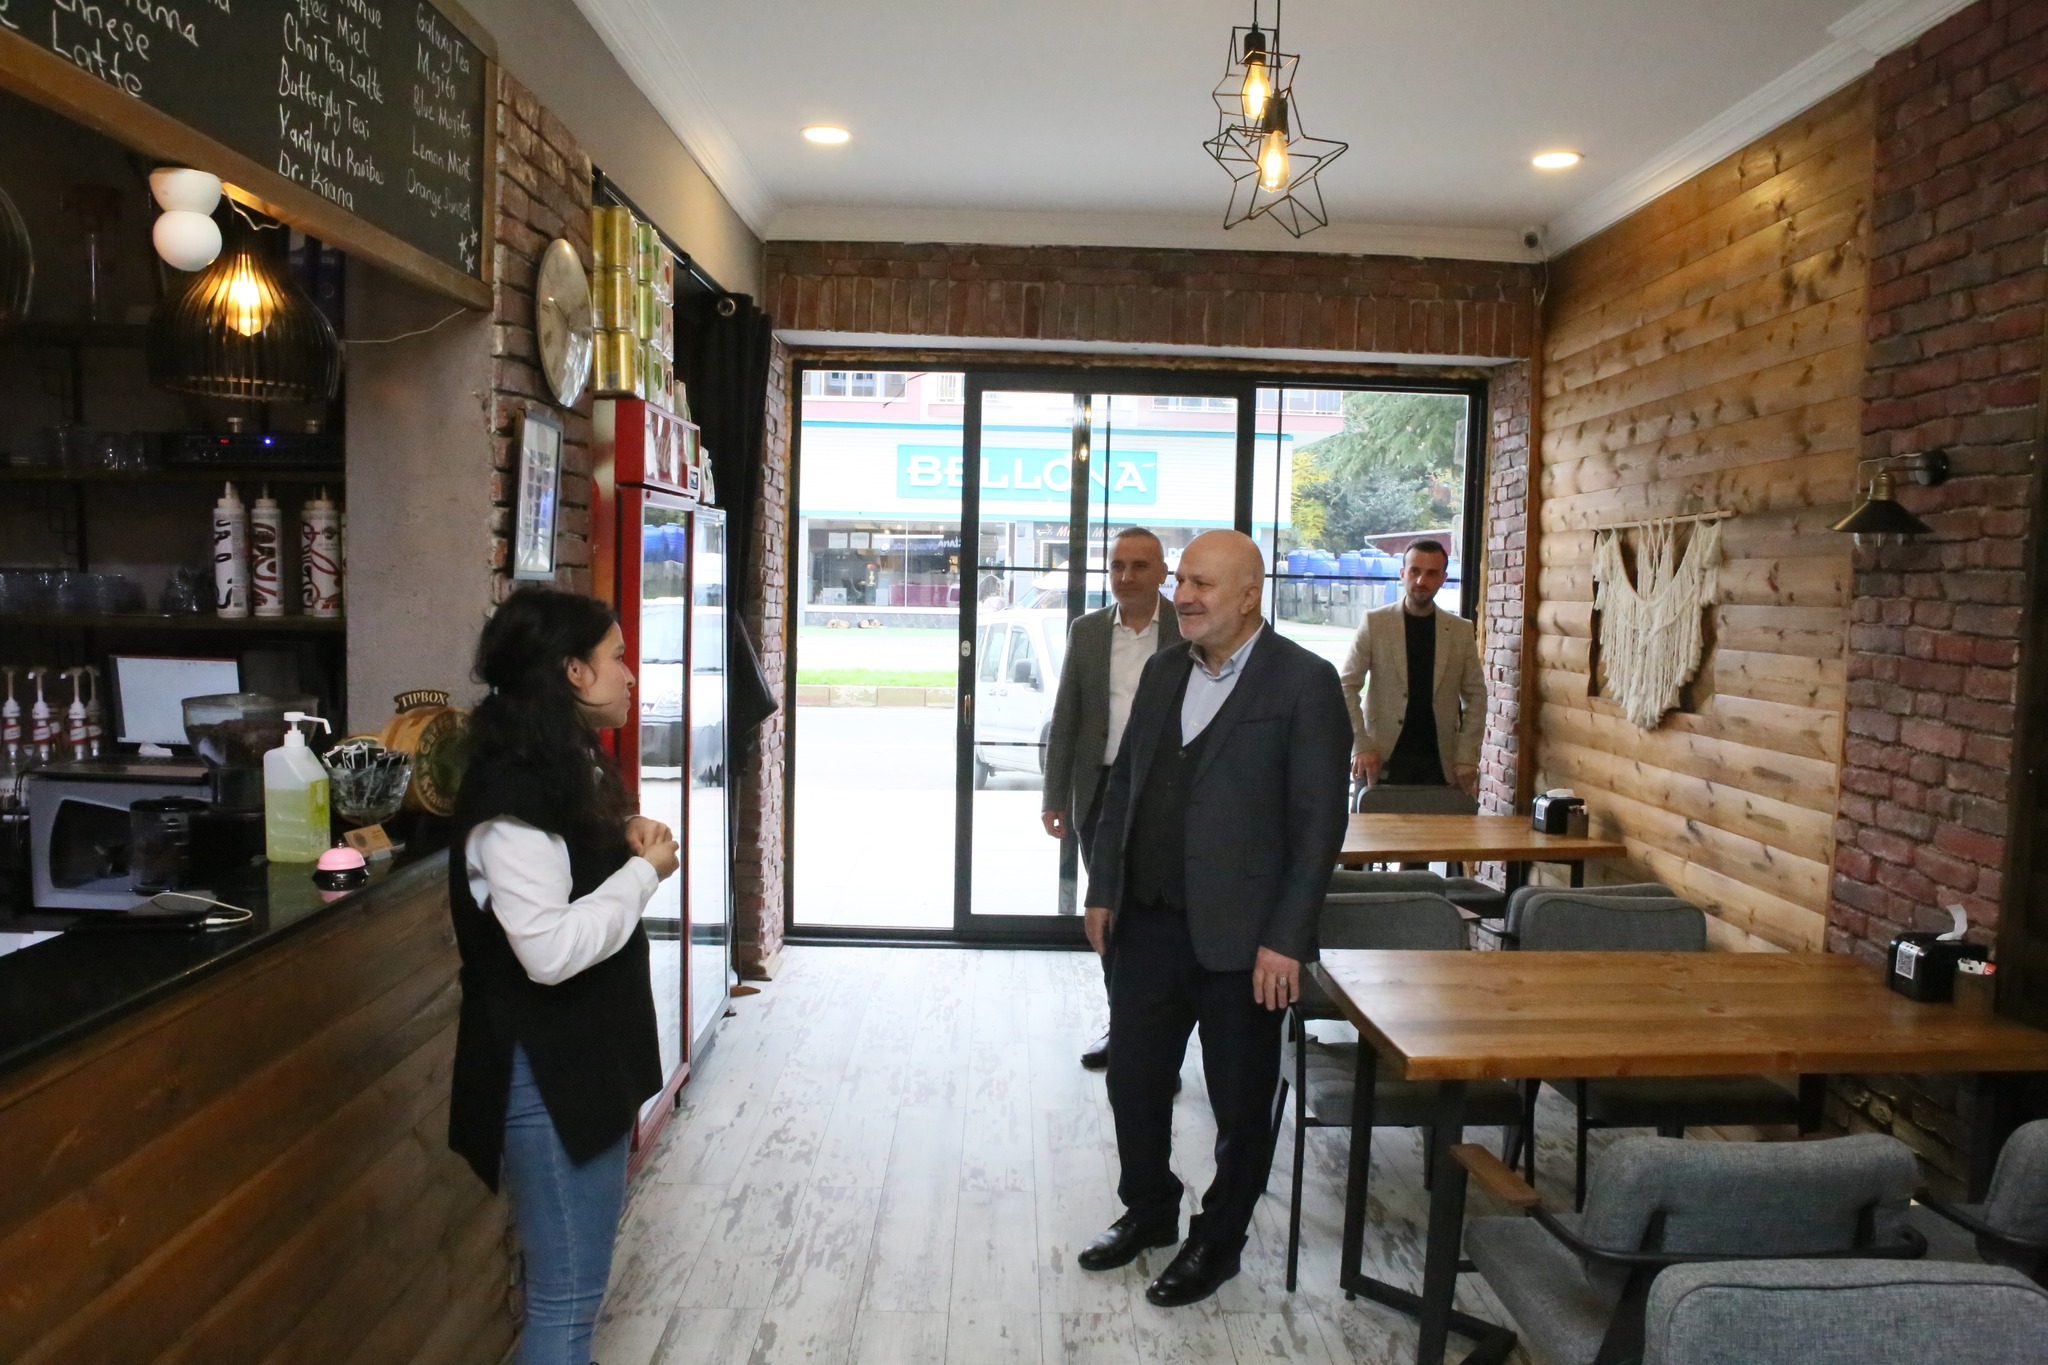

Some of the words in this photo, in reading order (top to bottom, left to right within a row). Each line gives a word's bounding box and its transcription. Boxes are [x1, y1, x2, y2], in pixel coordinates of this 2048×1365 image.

[52, 10, 142, 98] Latte
[284, 12, 318, 62] Chai
[321, 35, 345, 83] Tea
[337, 14, 369, 57] Miel
[416, 3, 453, 73] Galaxy
[454, 40, 470, 74] Tea
[417, 42, 456, 100] Mojito
[413, 85, 435, 119] Blue
[438, 105, 471, 138] Mojito
[278, 149, 304, 181] Dr.
[311, 168, 354, 212] Kiana
[412, 125, 444, 169] Lemon
[447, 149, 471, 181] Mint
[407, 168, 442, 217] Orange
[443, 187, 472, 221] Sunset
[399, 690, 448, 708] TIPBOX
